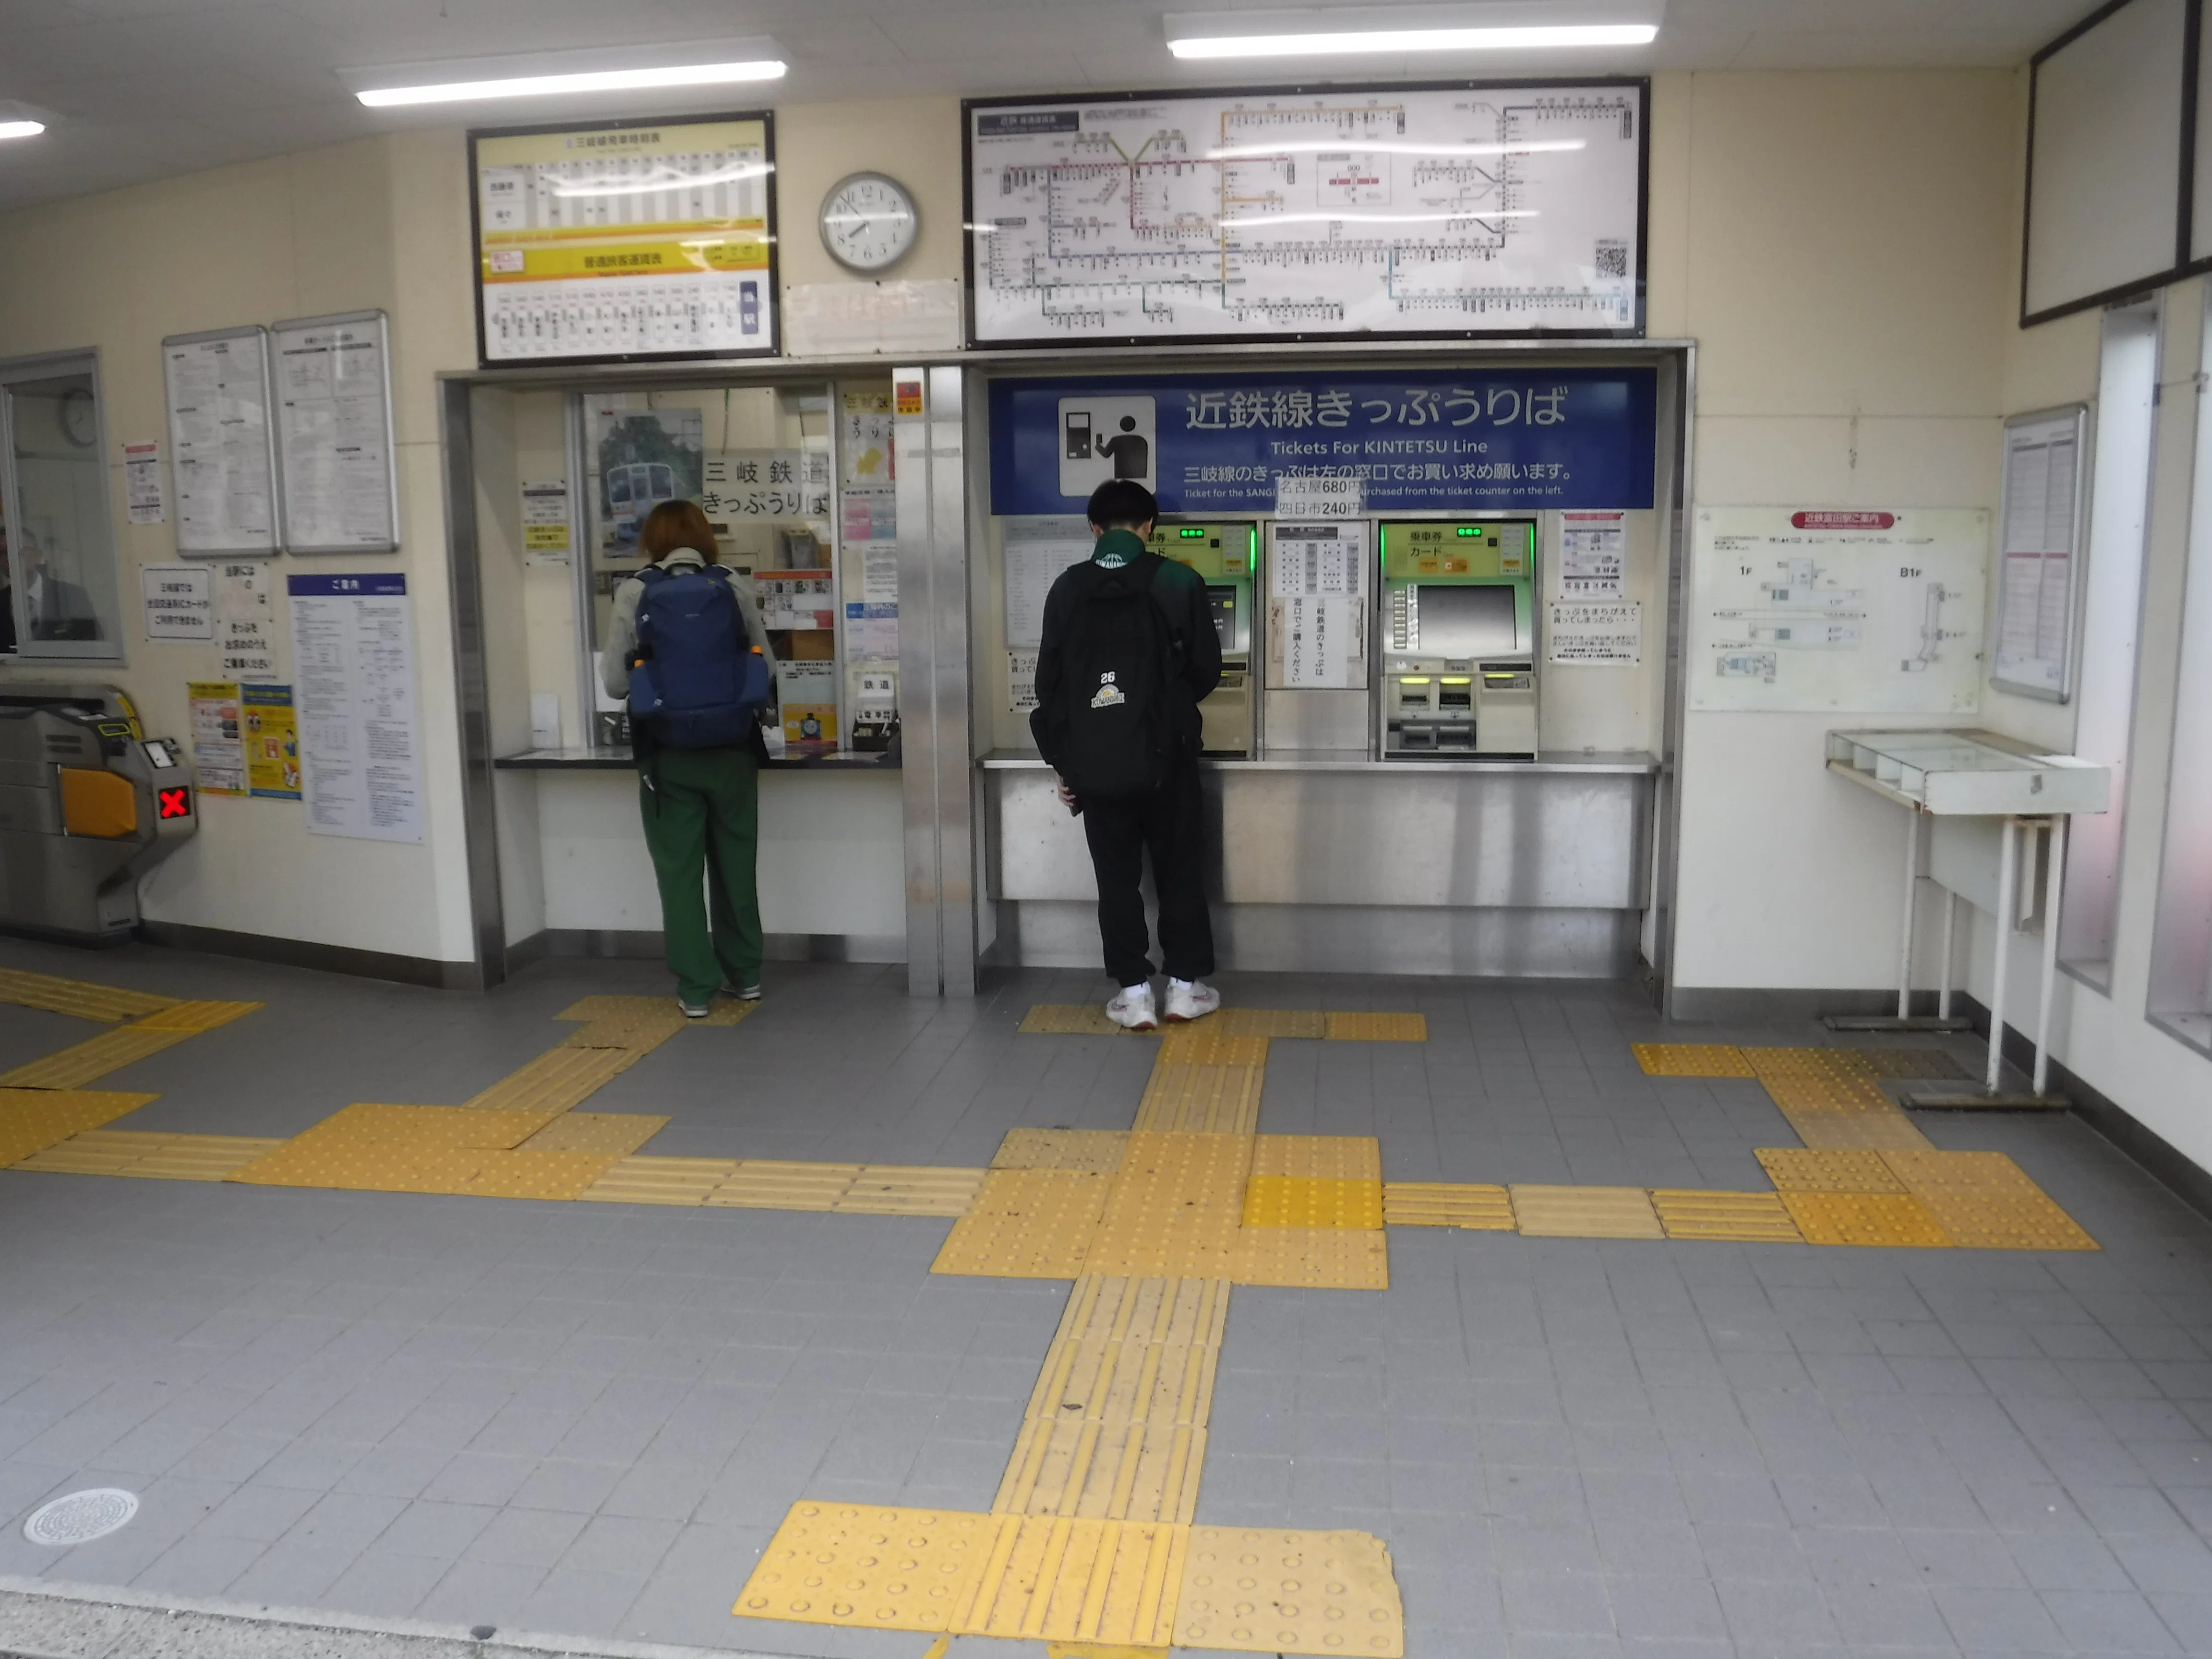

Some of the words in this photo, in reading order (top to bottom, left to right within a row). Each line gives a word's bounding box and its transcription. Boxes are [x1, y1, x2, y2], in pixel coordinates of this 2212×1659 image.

[1186, 385, 1568, 429] 近鉄線きっぷうりば
[1271, 441, 1328, 455] Tickets
[1333, 441, 1359, 454] For
[1364, 440, 1448, 454] KINTETSU
[1453, 439, 1488, 453] Line
[706, 460, 824, 484] 三岐鉄道
[1184, 463, 1571, 482] 三岐線のきっぷは左の窓口でお買い求め願います。
[1184, 489, 1211, 498] Ticket
[1212, 488, 1226, 497] for
[1228, 488, 1243, 497] the
[1280, 480, 1360, 494] 名古屋680円
[1360, 486, 1403, 495] urchased
[1405, 486, 1427, 495] from
[1429, 486, 1444, 495] the
[1447, 486, 1472, 495] ticket
[1475, 487, 1510, 495] counter
[1527, 486, 1543, 494] the
[1545, 486, 1563, 494] left.
[703, 491, 828, 515] きっぷうりば
[1279, 502, 1360, 515] 四日市240円
[1410, 547, 1442, 557] カード
[1741, 565, 1752, 576] 1F
[1101, 671, 1115, 684] 26
